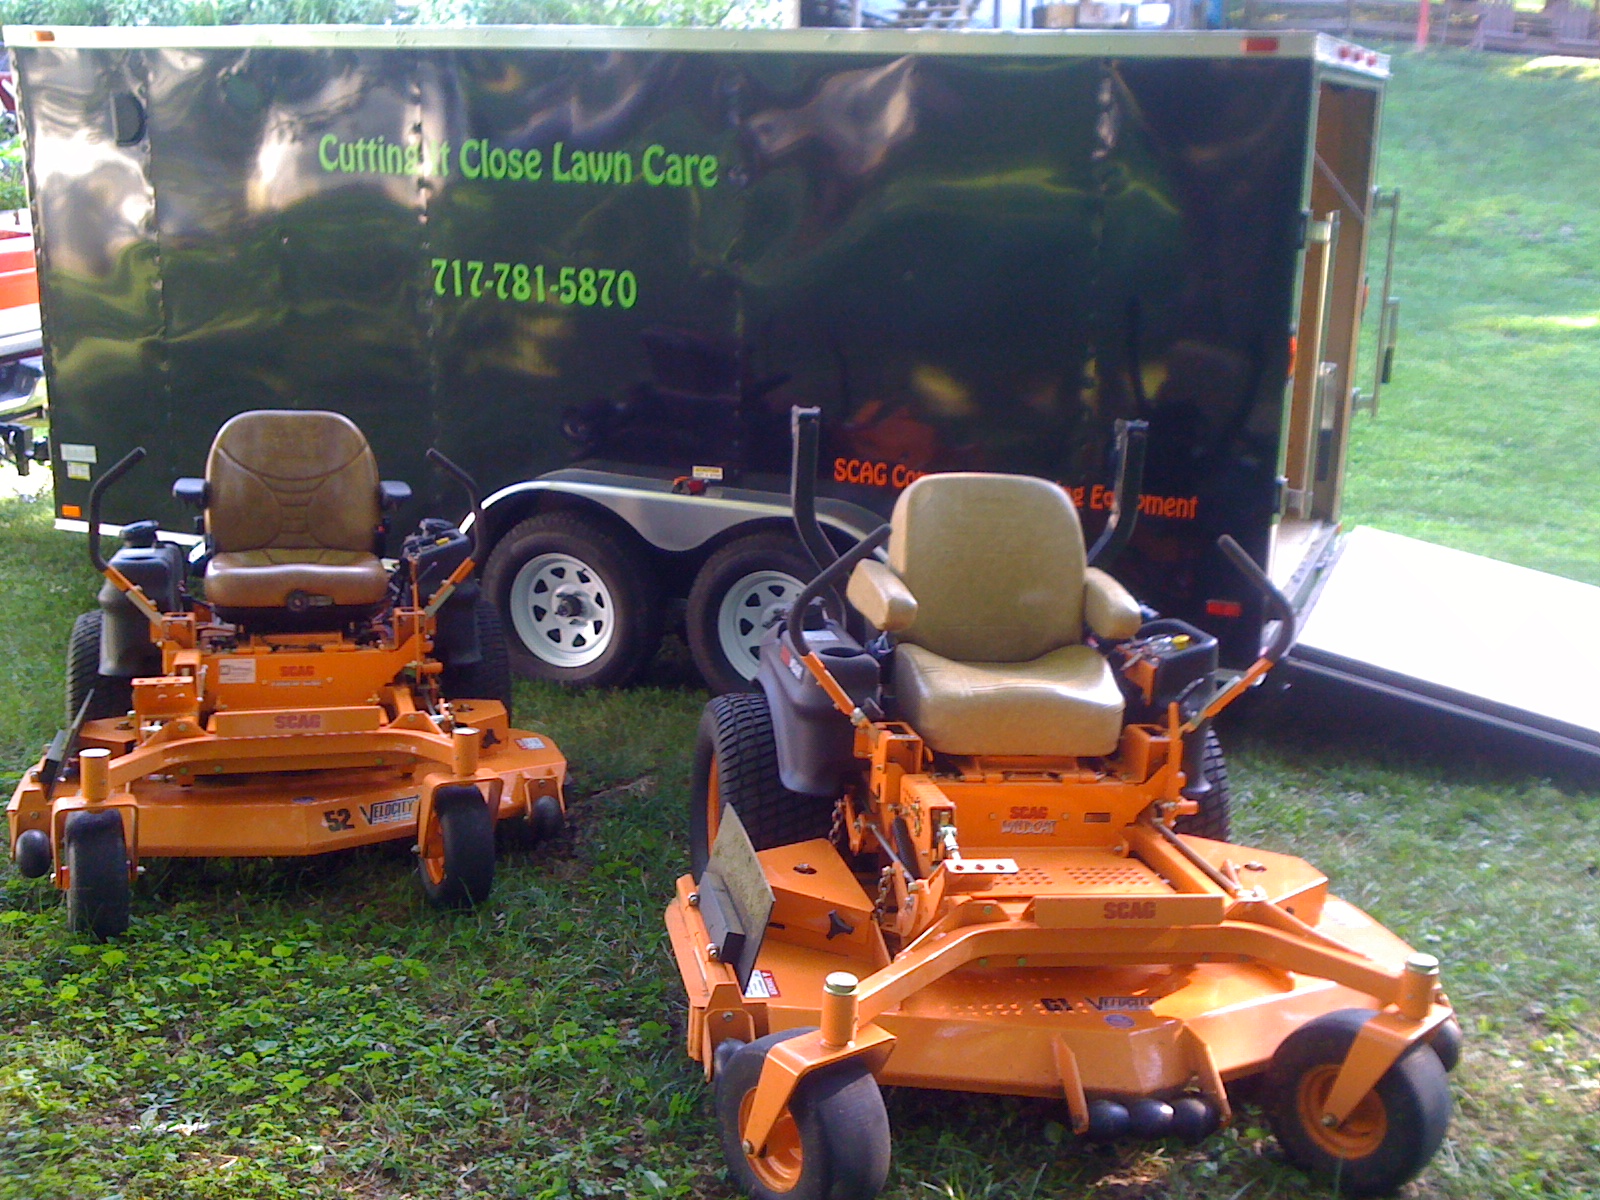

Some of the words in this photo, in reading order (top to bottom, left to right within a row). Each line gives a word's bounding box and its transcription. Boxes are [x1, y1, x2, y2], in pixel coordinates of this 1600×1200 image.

[318, 134, 421, 175] Cutting
[429, 139, 451, 177] It
[459, 138, 542, 182] Close
[552, 141, 634, 185] Lawn
[642, 144, 719, 188] Care
[431, 258, 638, 309] 717-781-5870
[834, 457, 888, 486] SCAG
[1090, 484, 1199, 520] Eqment
[279, 665, 315, 677] SCAG
[274, 714, 321, 729] SCAG
[323, 808, 355, 832] 52
[1009, 806, 1049, 819] SCAG
[1104, 901, 1156, 919] SCAG
